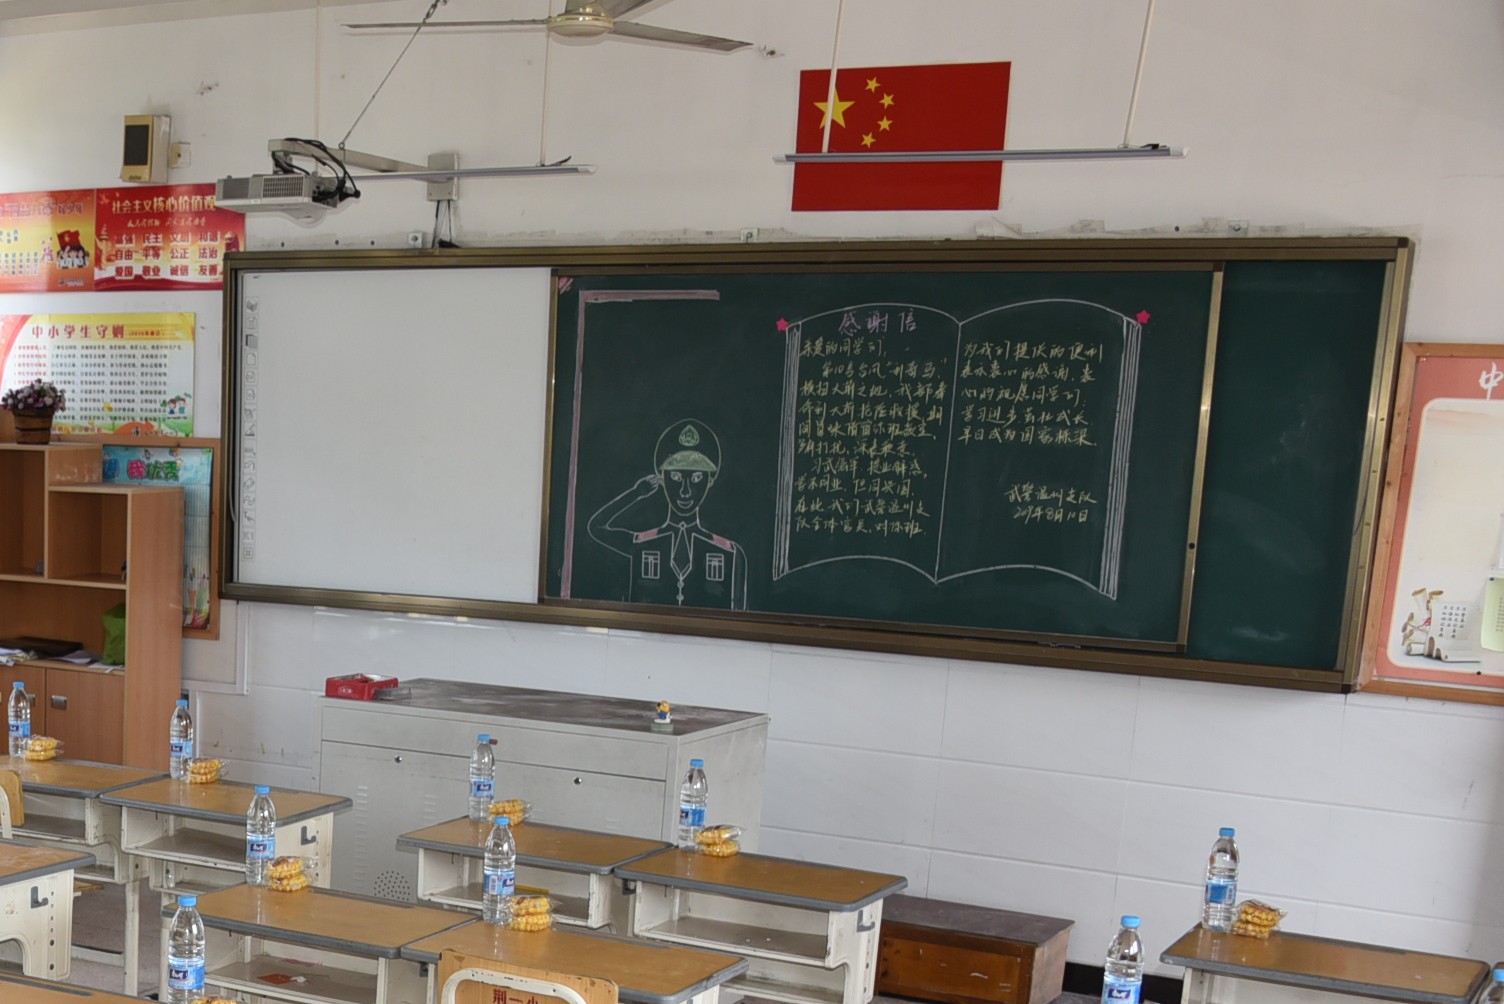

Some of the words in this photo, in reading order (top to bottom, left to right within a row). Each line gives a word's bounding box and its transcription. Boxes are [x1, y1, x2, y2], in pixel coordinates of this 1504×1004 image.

[112, 195, 216, 214] 社会主义核心价值观
[115, 249, 133, 260] 自由
[170, 247, 189, 259] 公正
[32, 324, 124, 339] 中小学生守则
[838, 309, 917, 337] 感谢信
[1478, 361, 1504, 401] 中
